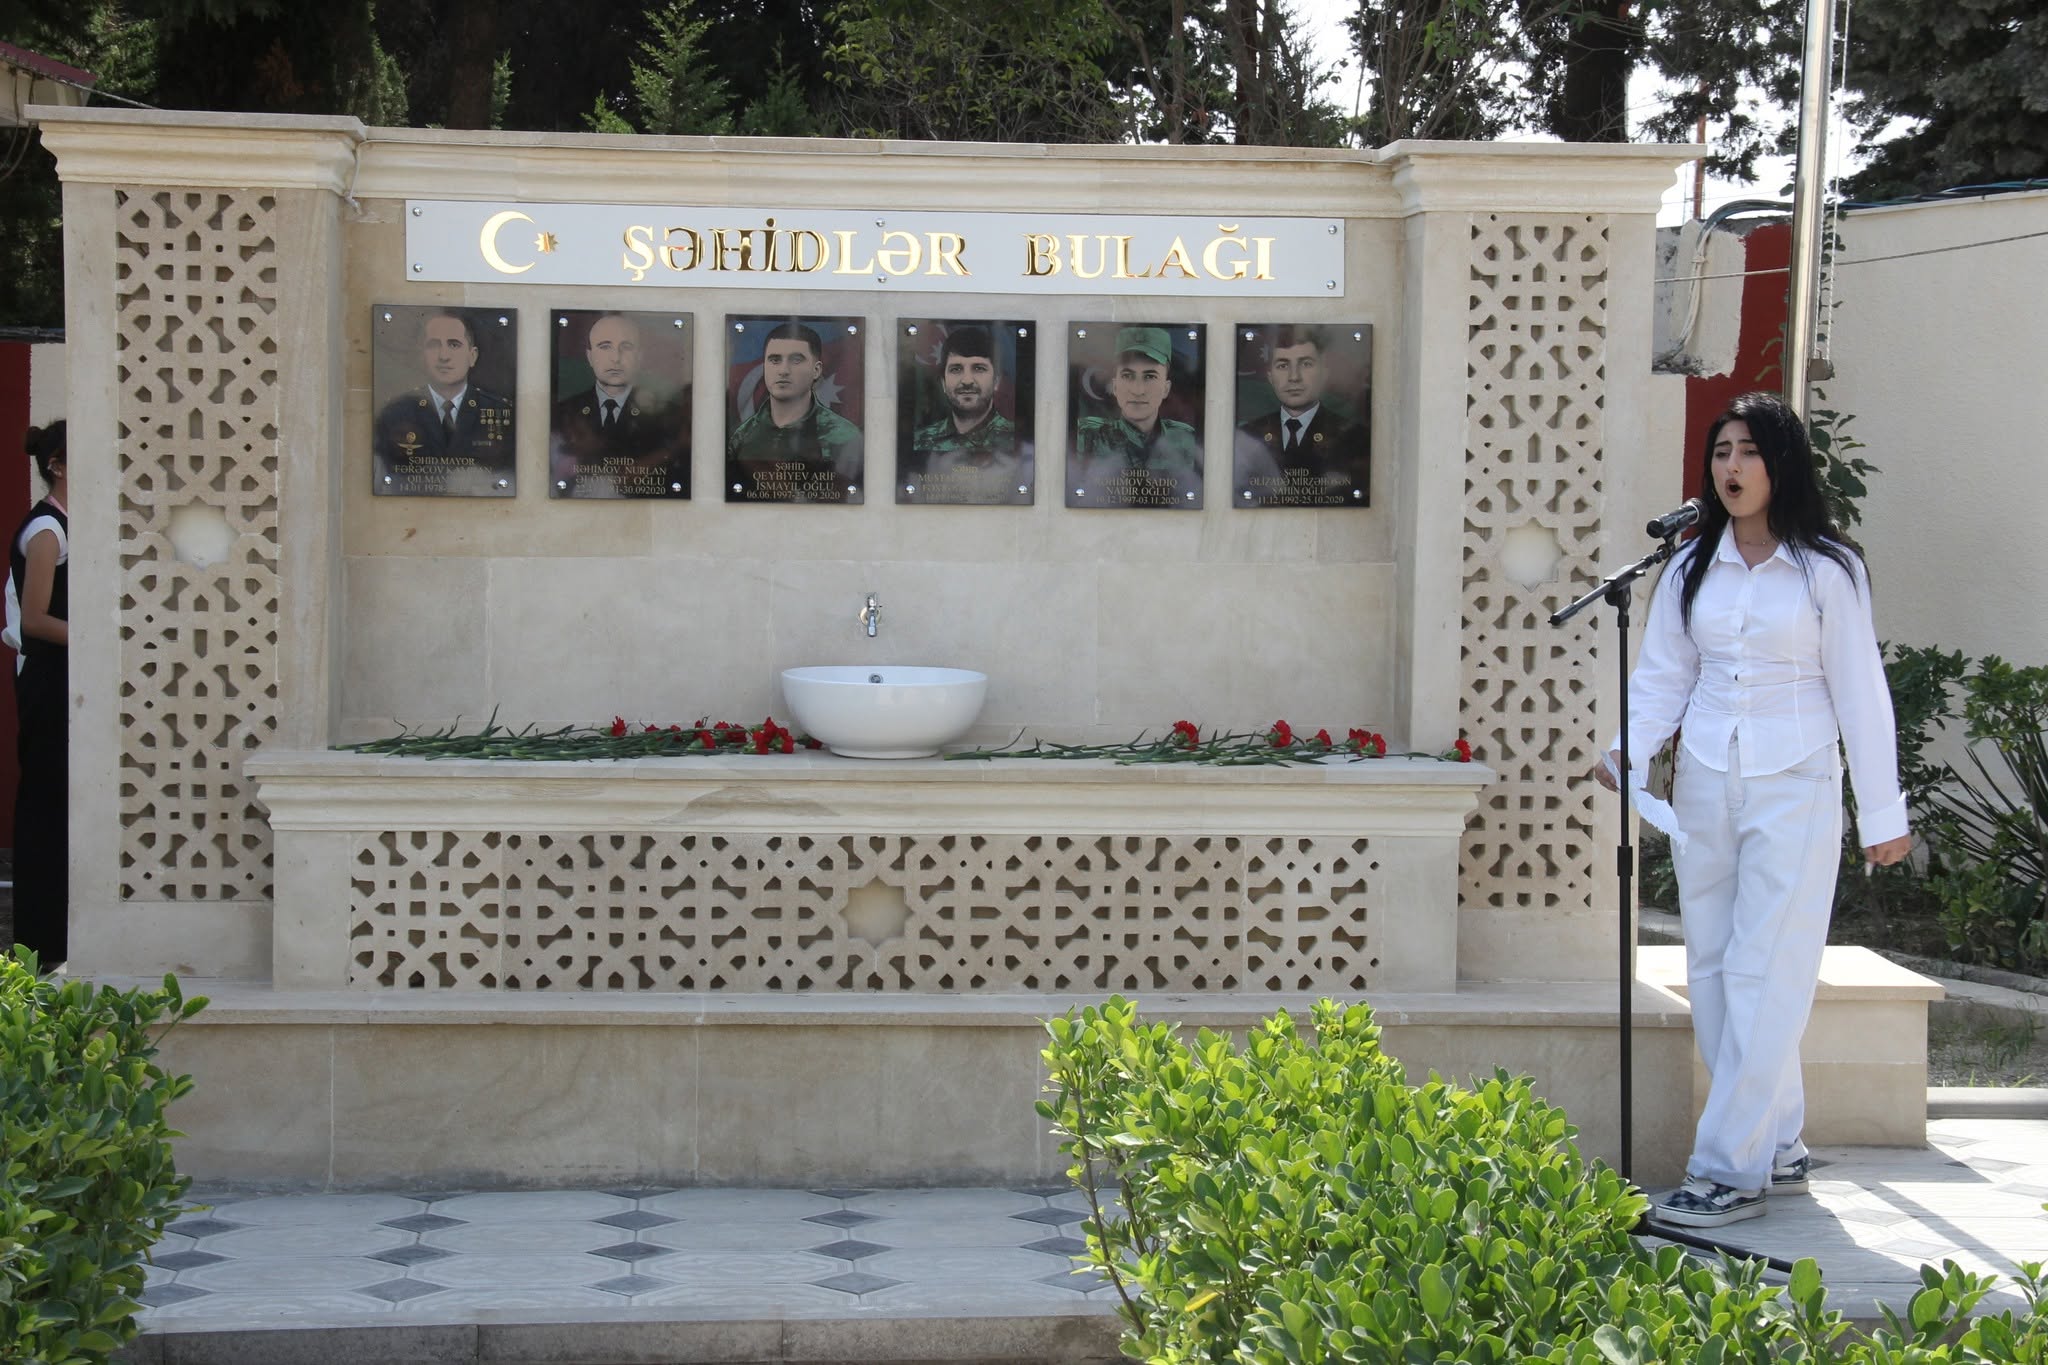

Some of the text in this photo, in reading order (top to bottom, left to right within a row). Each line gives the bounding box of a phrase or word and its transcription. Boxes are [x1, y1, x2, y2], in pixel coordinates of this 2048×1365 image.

[622, 217, 1276, 281] ŞƏHİDLƏR BULAĞI
[440, 457, 476, 466] MAYOR
[603, 456, 635, 467] ŞƏHİD
[775, 461, 806, 472] ŞƏHİD
[625, 465, 668, 475] NURLAN
[811, 470, 837, 481] ARİF
[1121, 469, 1151, 479] ŞƏHİD
[633, 475, 666, 486] OĞLU
[803, 480, 835, 491] OĞLU
[1141, 486, 1170, 496] OĞLU
[1301, 486, 1328, 496] OĞLU
